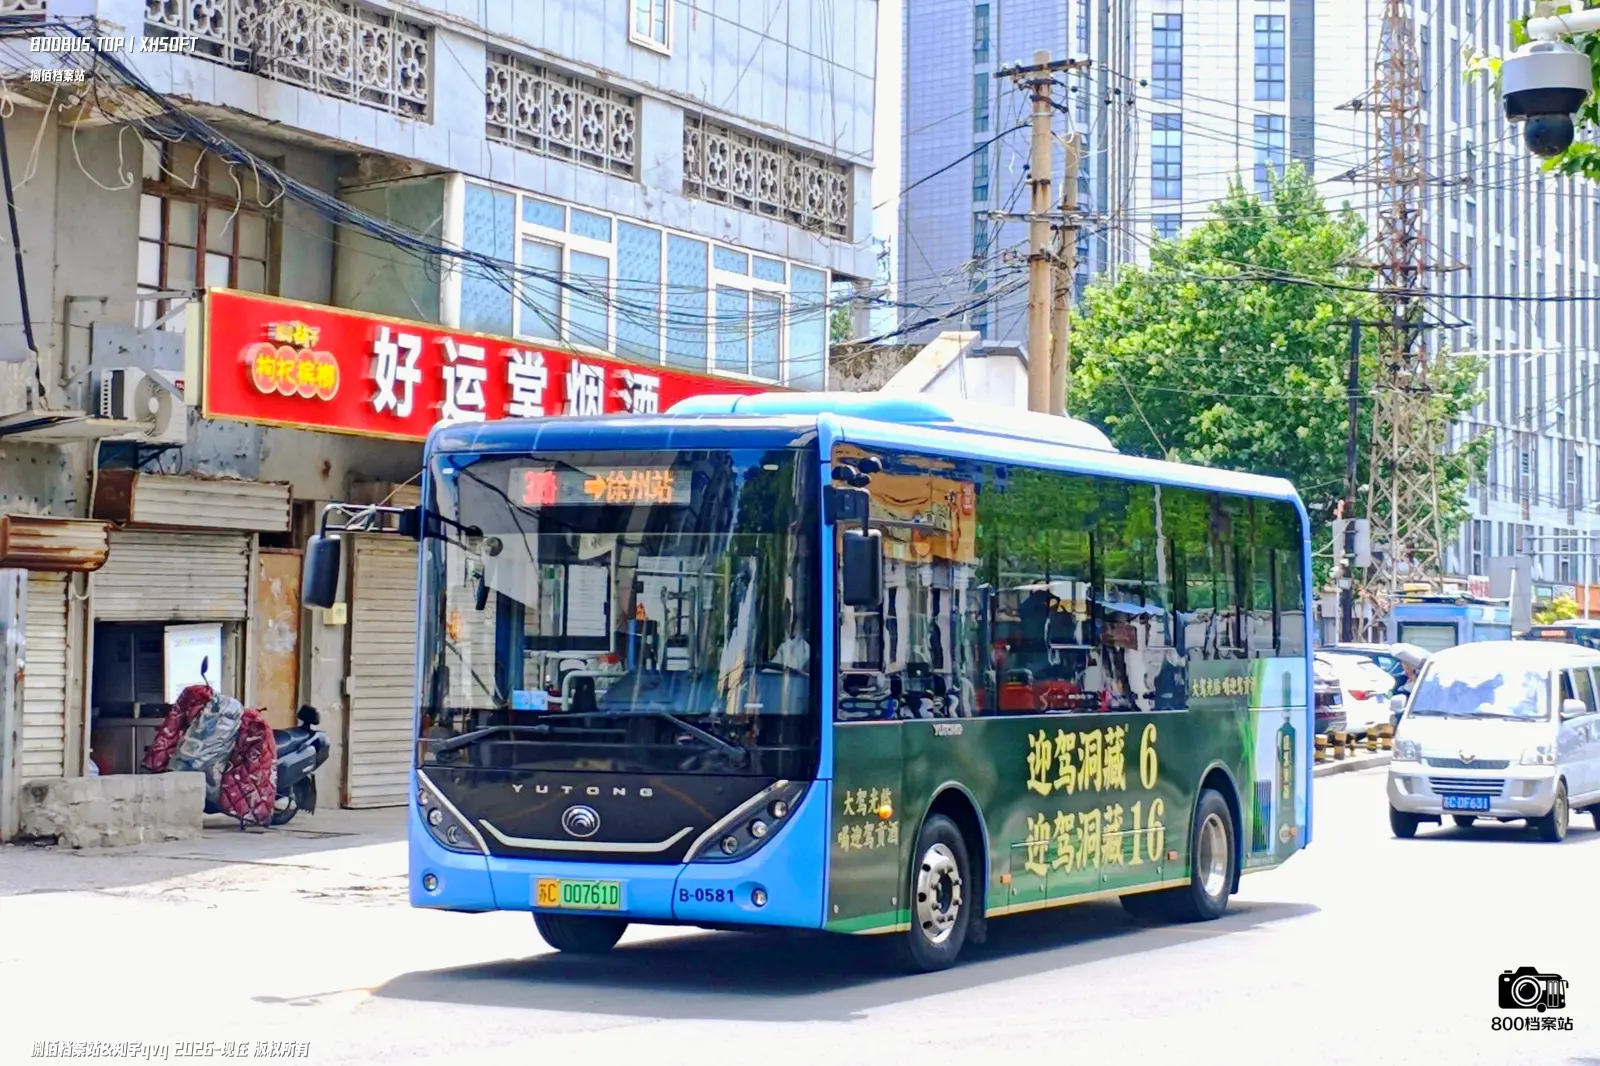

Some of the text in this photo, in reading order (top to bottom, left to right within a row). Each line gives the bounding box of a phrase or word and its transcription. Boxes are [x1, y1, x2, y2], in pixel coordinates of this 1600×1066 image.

[607, 470, 675, 504] 徐州站
[1026, 722, 1158, 796] 迎驾洞藏 6
[512, 784, 653, 797] YUTONG
[679, 888, 734, 902] B-0581
